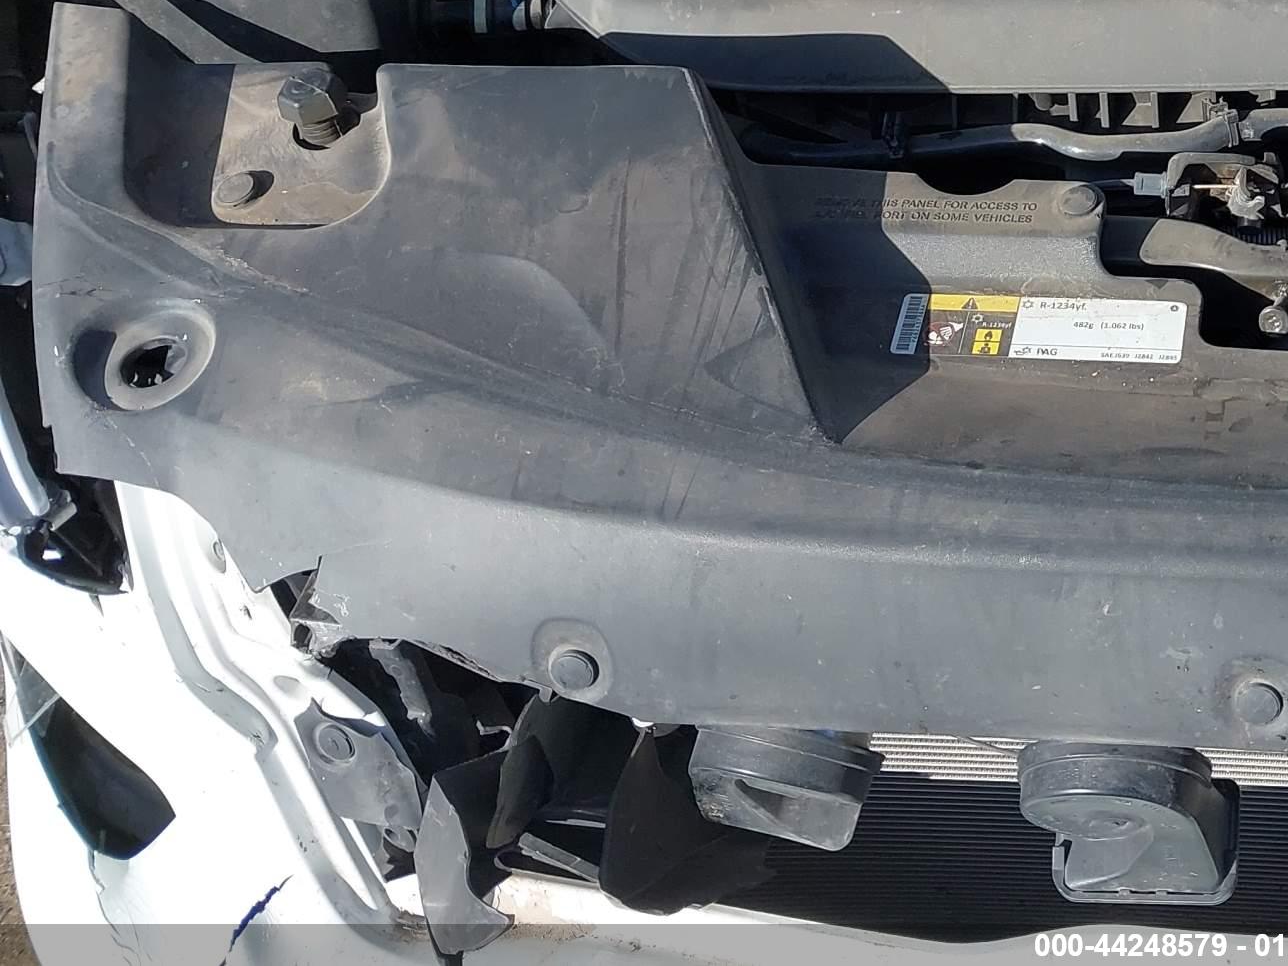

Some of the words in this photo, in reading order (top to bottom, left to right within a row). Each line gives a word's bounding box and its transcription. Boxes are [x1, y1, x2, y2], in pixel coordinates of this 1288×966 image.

[902, 199, 940, 210] PANEL
[944, 200, 969, 210] FOR
[970, 201, 1019, 212] ACCESS
[1022, 202, 1038, 212] TO
[911, 212, 930, 222] ON
[933, 212, 969, 223] SOME
[974, 213, 1033, 224] VEHICLES
[1073, 321, 1094, 330] 482g
[1100, 321, 1126, 331] (1.062
[1128, 322, 1145, 331] lbs)
[1036, 347, 1058, 357] PAG
